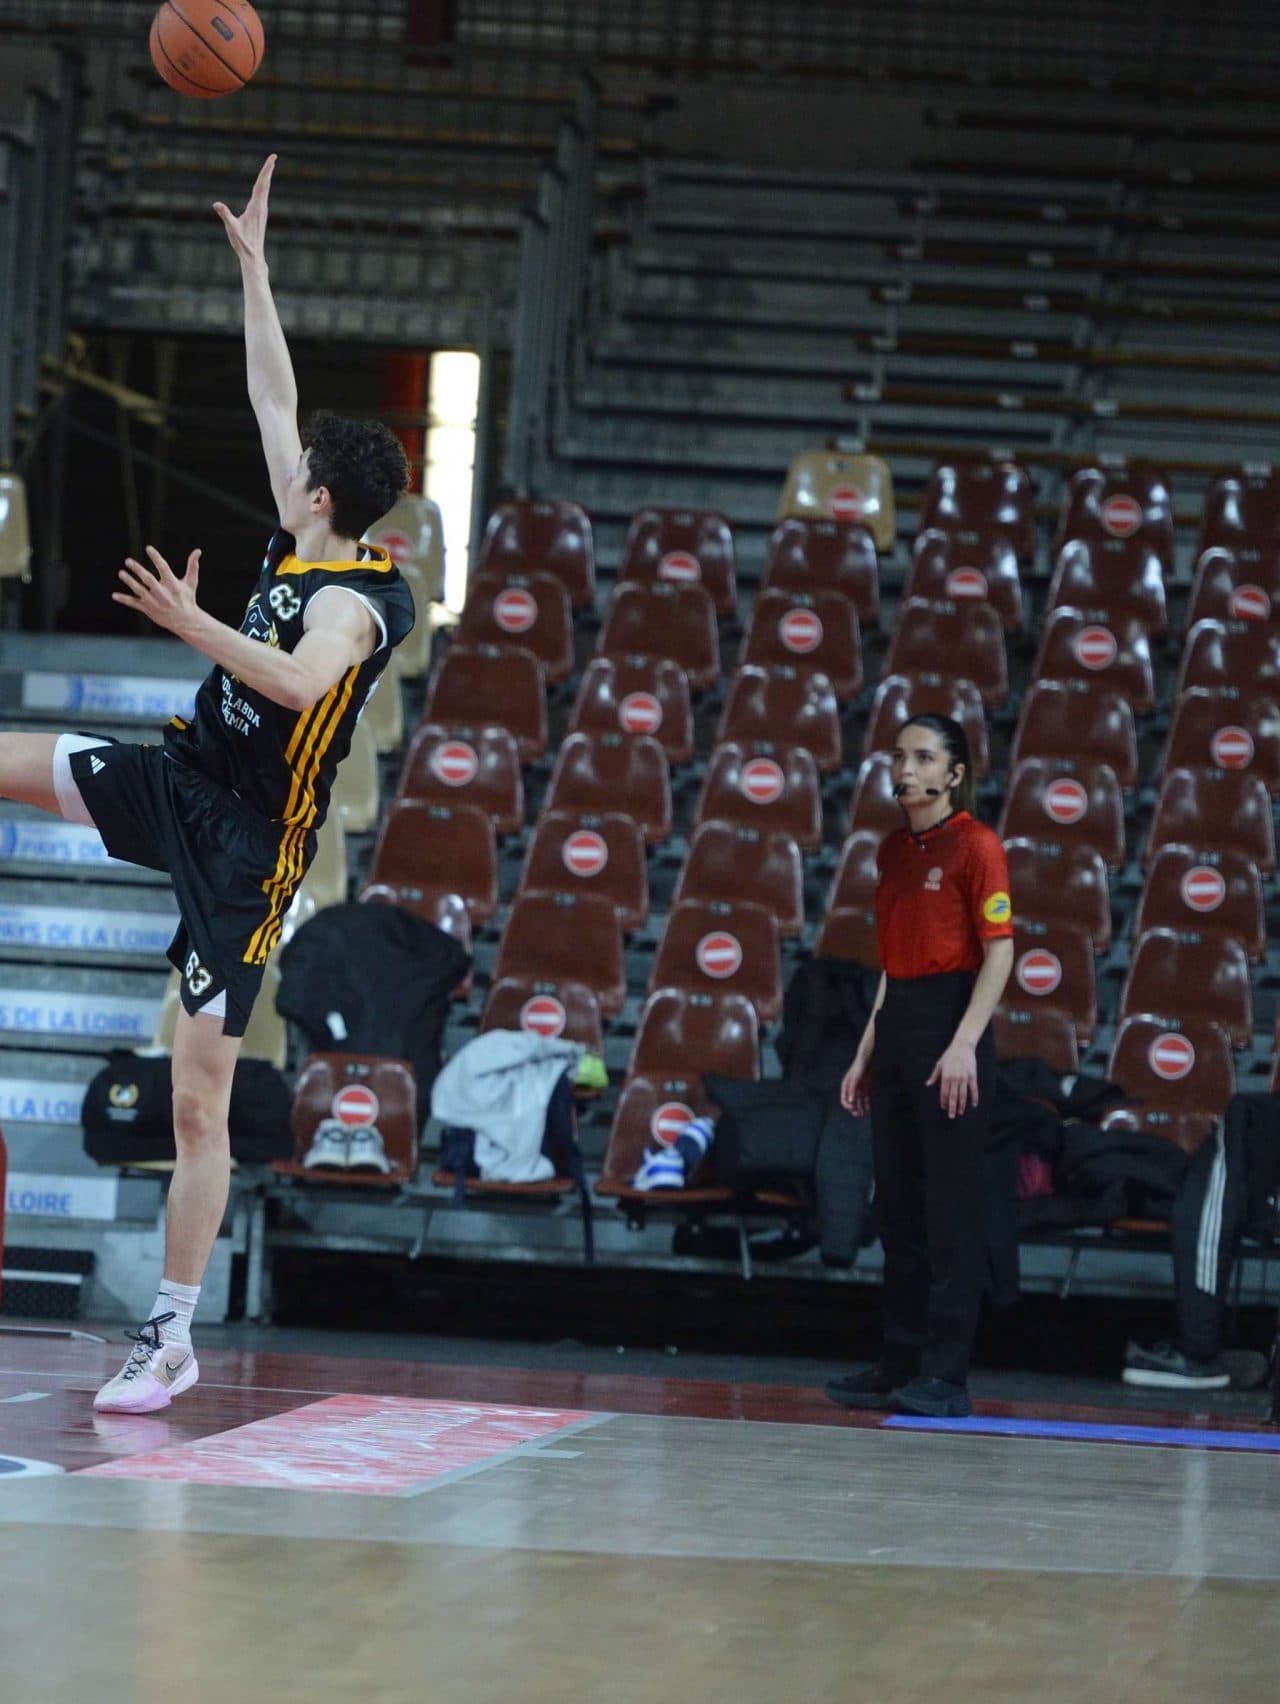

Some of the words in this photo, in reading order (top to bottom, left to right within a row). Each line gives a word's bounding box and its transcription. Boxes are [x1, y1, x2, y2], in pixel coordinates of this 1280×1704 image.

[269, 583, 302, 622] 63
[46, 923, 75, 944] DE
[80, 927, 108, 946] LA
[186, 950, 212, 996] 63
[14, 1006, 41, 1028] DE
[49, 1009, 76, 1030] LA
[82, 1011, 143, 1035] LOIRE
[10, 1097, 37, 1119] LA
[43, 1100, 82, 1122] LOI
[8, 1191, 73, 1215] LOIRE
